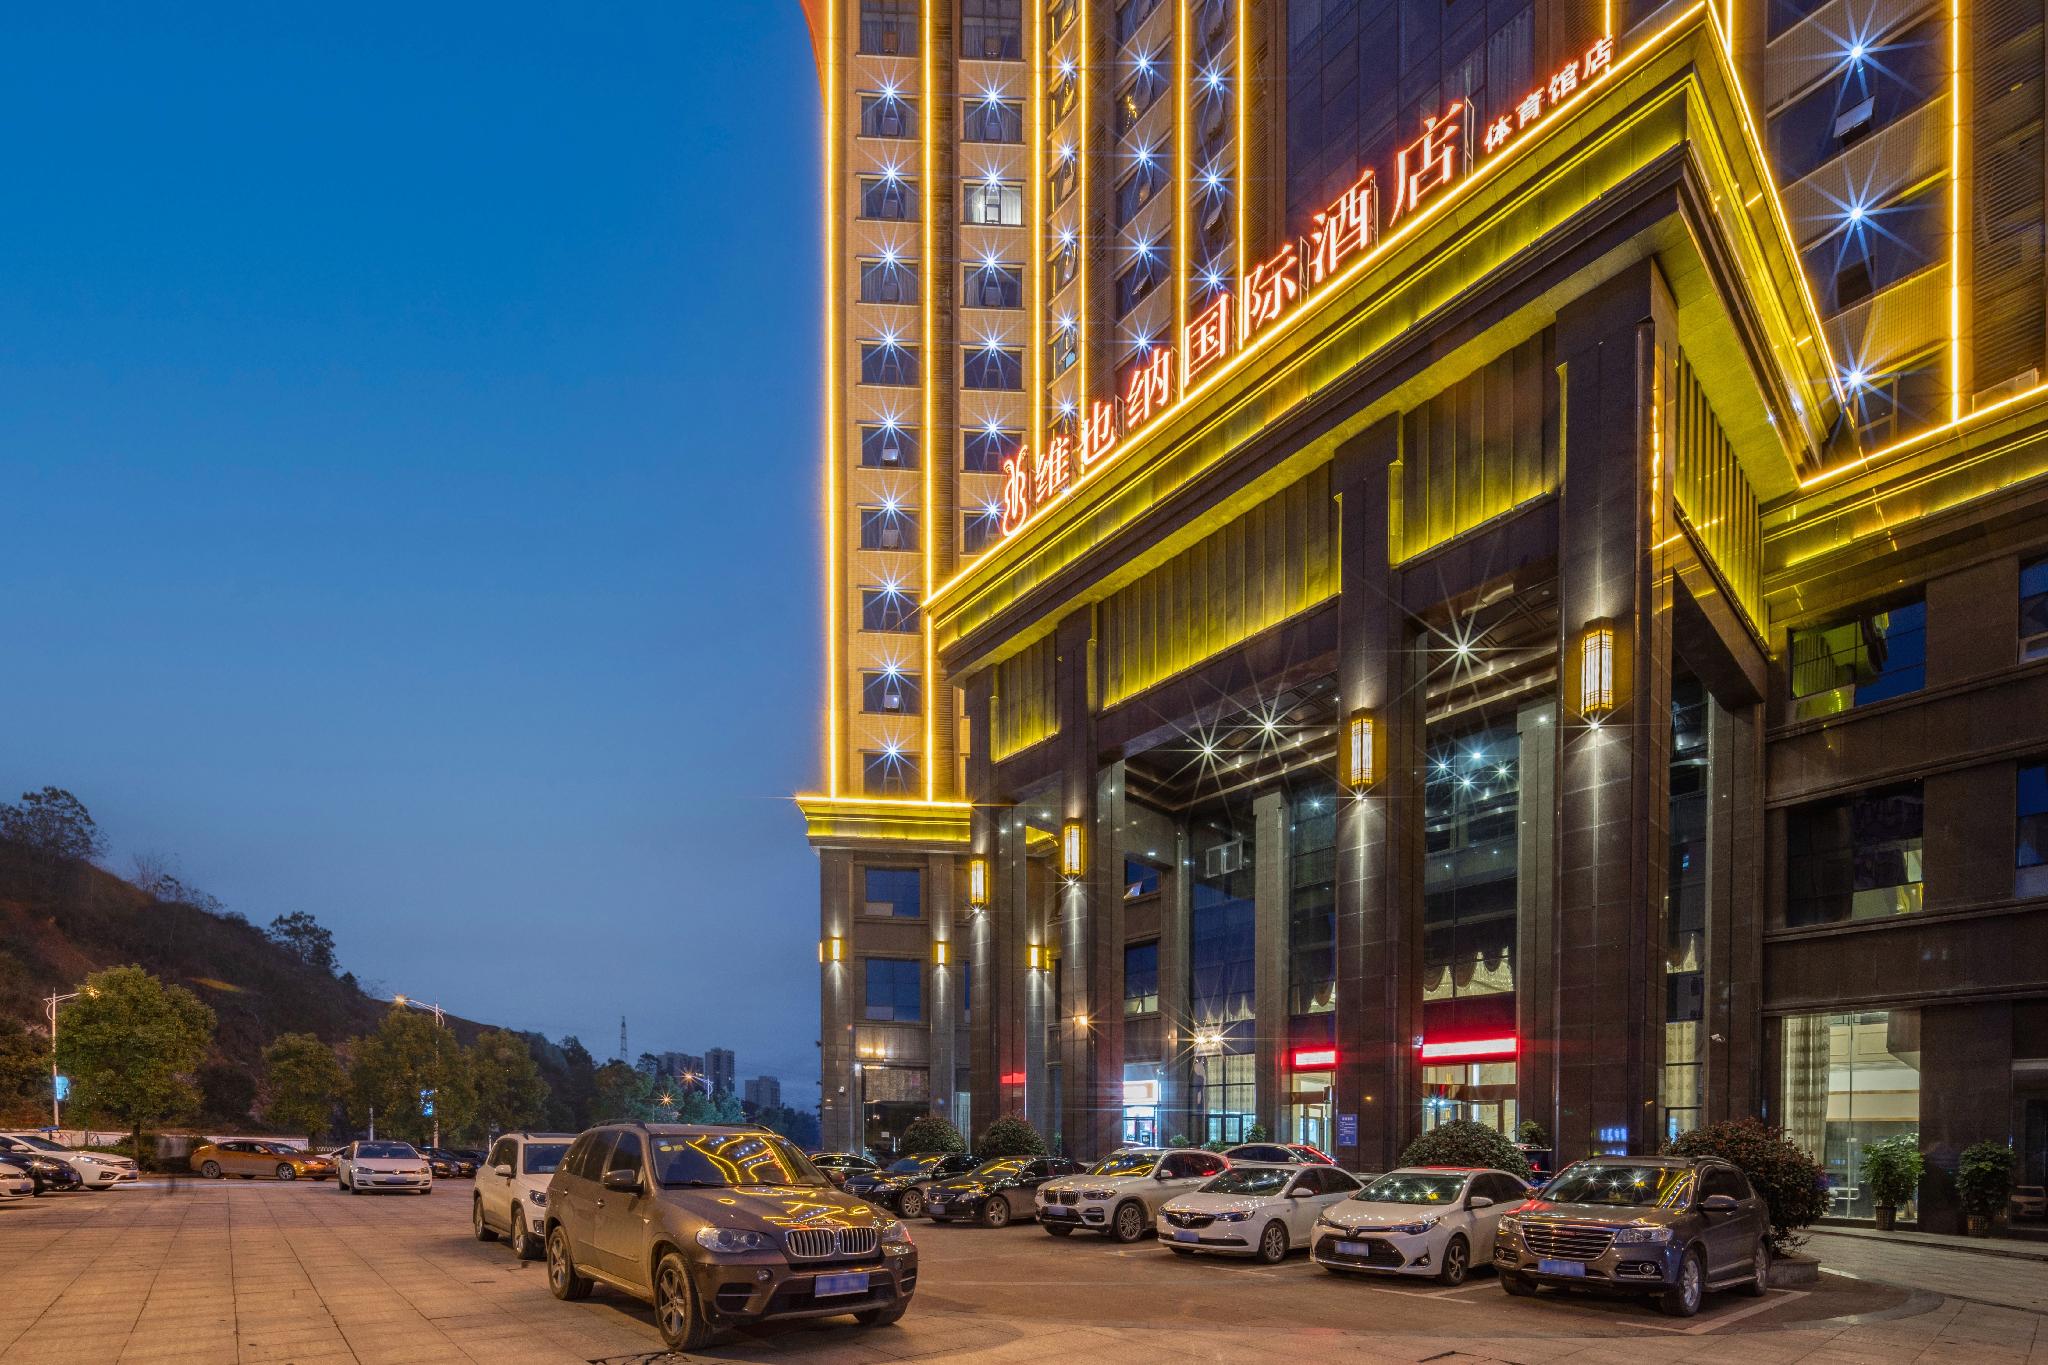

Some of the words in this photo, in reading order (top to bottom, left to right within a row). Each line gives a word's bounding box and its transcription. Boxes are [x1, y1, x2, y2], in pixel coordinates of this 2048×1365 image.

[1036, 104, 1463, 502] 维也纳国际酒店
[1484, 34, 1613, 153] 体育馆店
